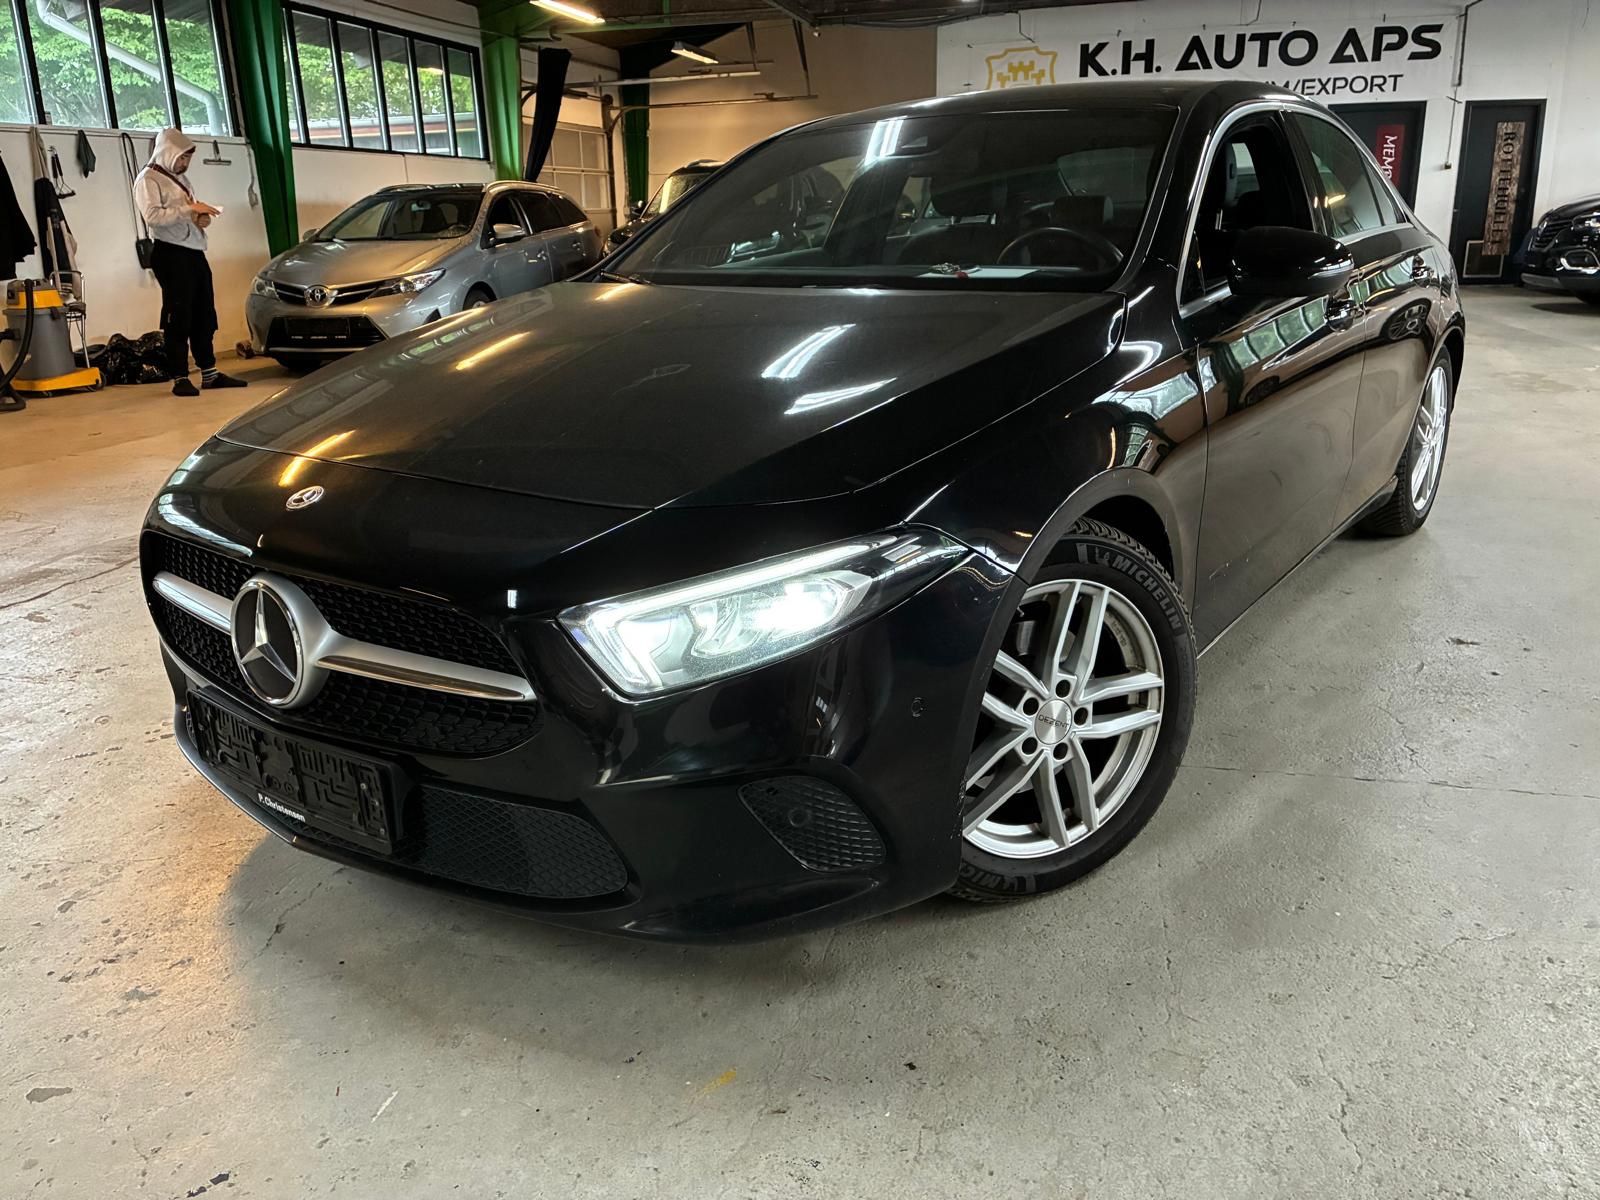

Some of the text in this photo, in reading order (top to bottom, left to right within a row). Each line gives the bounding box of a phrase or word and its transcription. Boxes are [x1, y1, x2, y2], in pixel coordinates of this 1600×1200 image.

[1079, 24, 1444, 78] K.H. AUTO APS
[1112, 555, 1182, 636] MICHELIN
[1038, 714, 1069, 729] DEZENT
